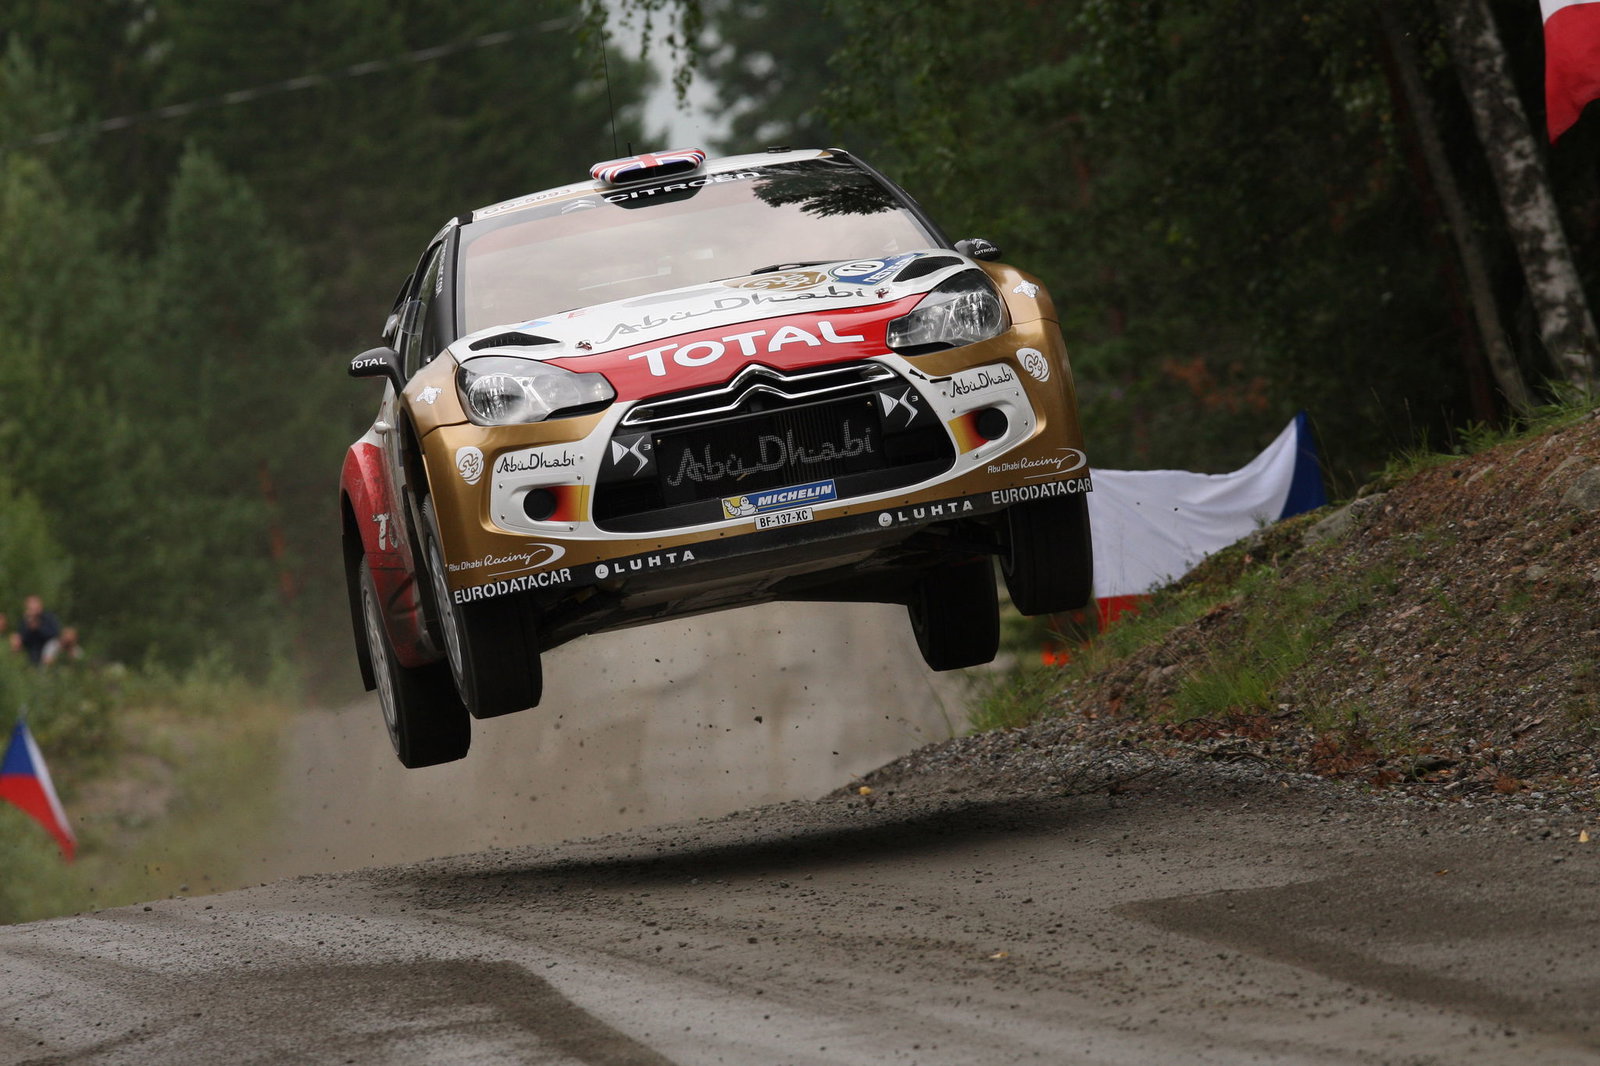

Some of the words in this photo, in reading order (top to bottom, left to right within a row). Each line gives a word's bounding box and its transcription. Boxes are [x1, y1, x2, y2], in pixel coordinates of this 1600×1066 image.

[628, 321, 865, 377] TOTAL
[351, 357, 387, 370] TOTAL
[987, 465, 1001, 474] Abu
[1001, 462, 1020, 472] Dhabi
[1020, 454, 1075, 470] Racing
[757, 484, 833, 507] MICHELIN
[991, 478, 1092, 505] EURODATACAR
[759, 510, 808, 529] BF-137-XC
[897, 500, 974, 522] LUHTA
[448, 563, 460, 572] Abu
[460, 559, 483, 571] Dhabi
[484, 548, 546, 567] Racing
[614, 550, 695, 574] LUHTA
[454, 567, 572, 604] EURODATACAR
